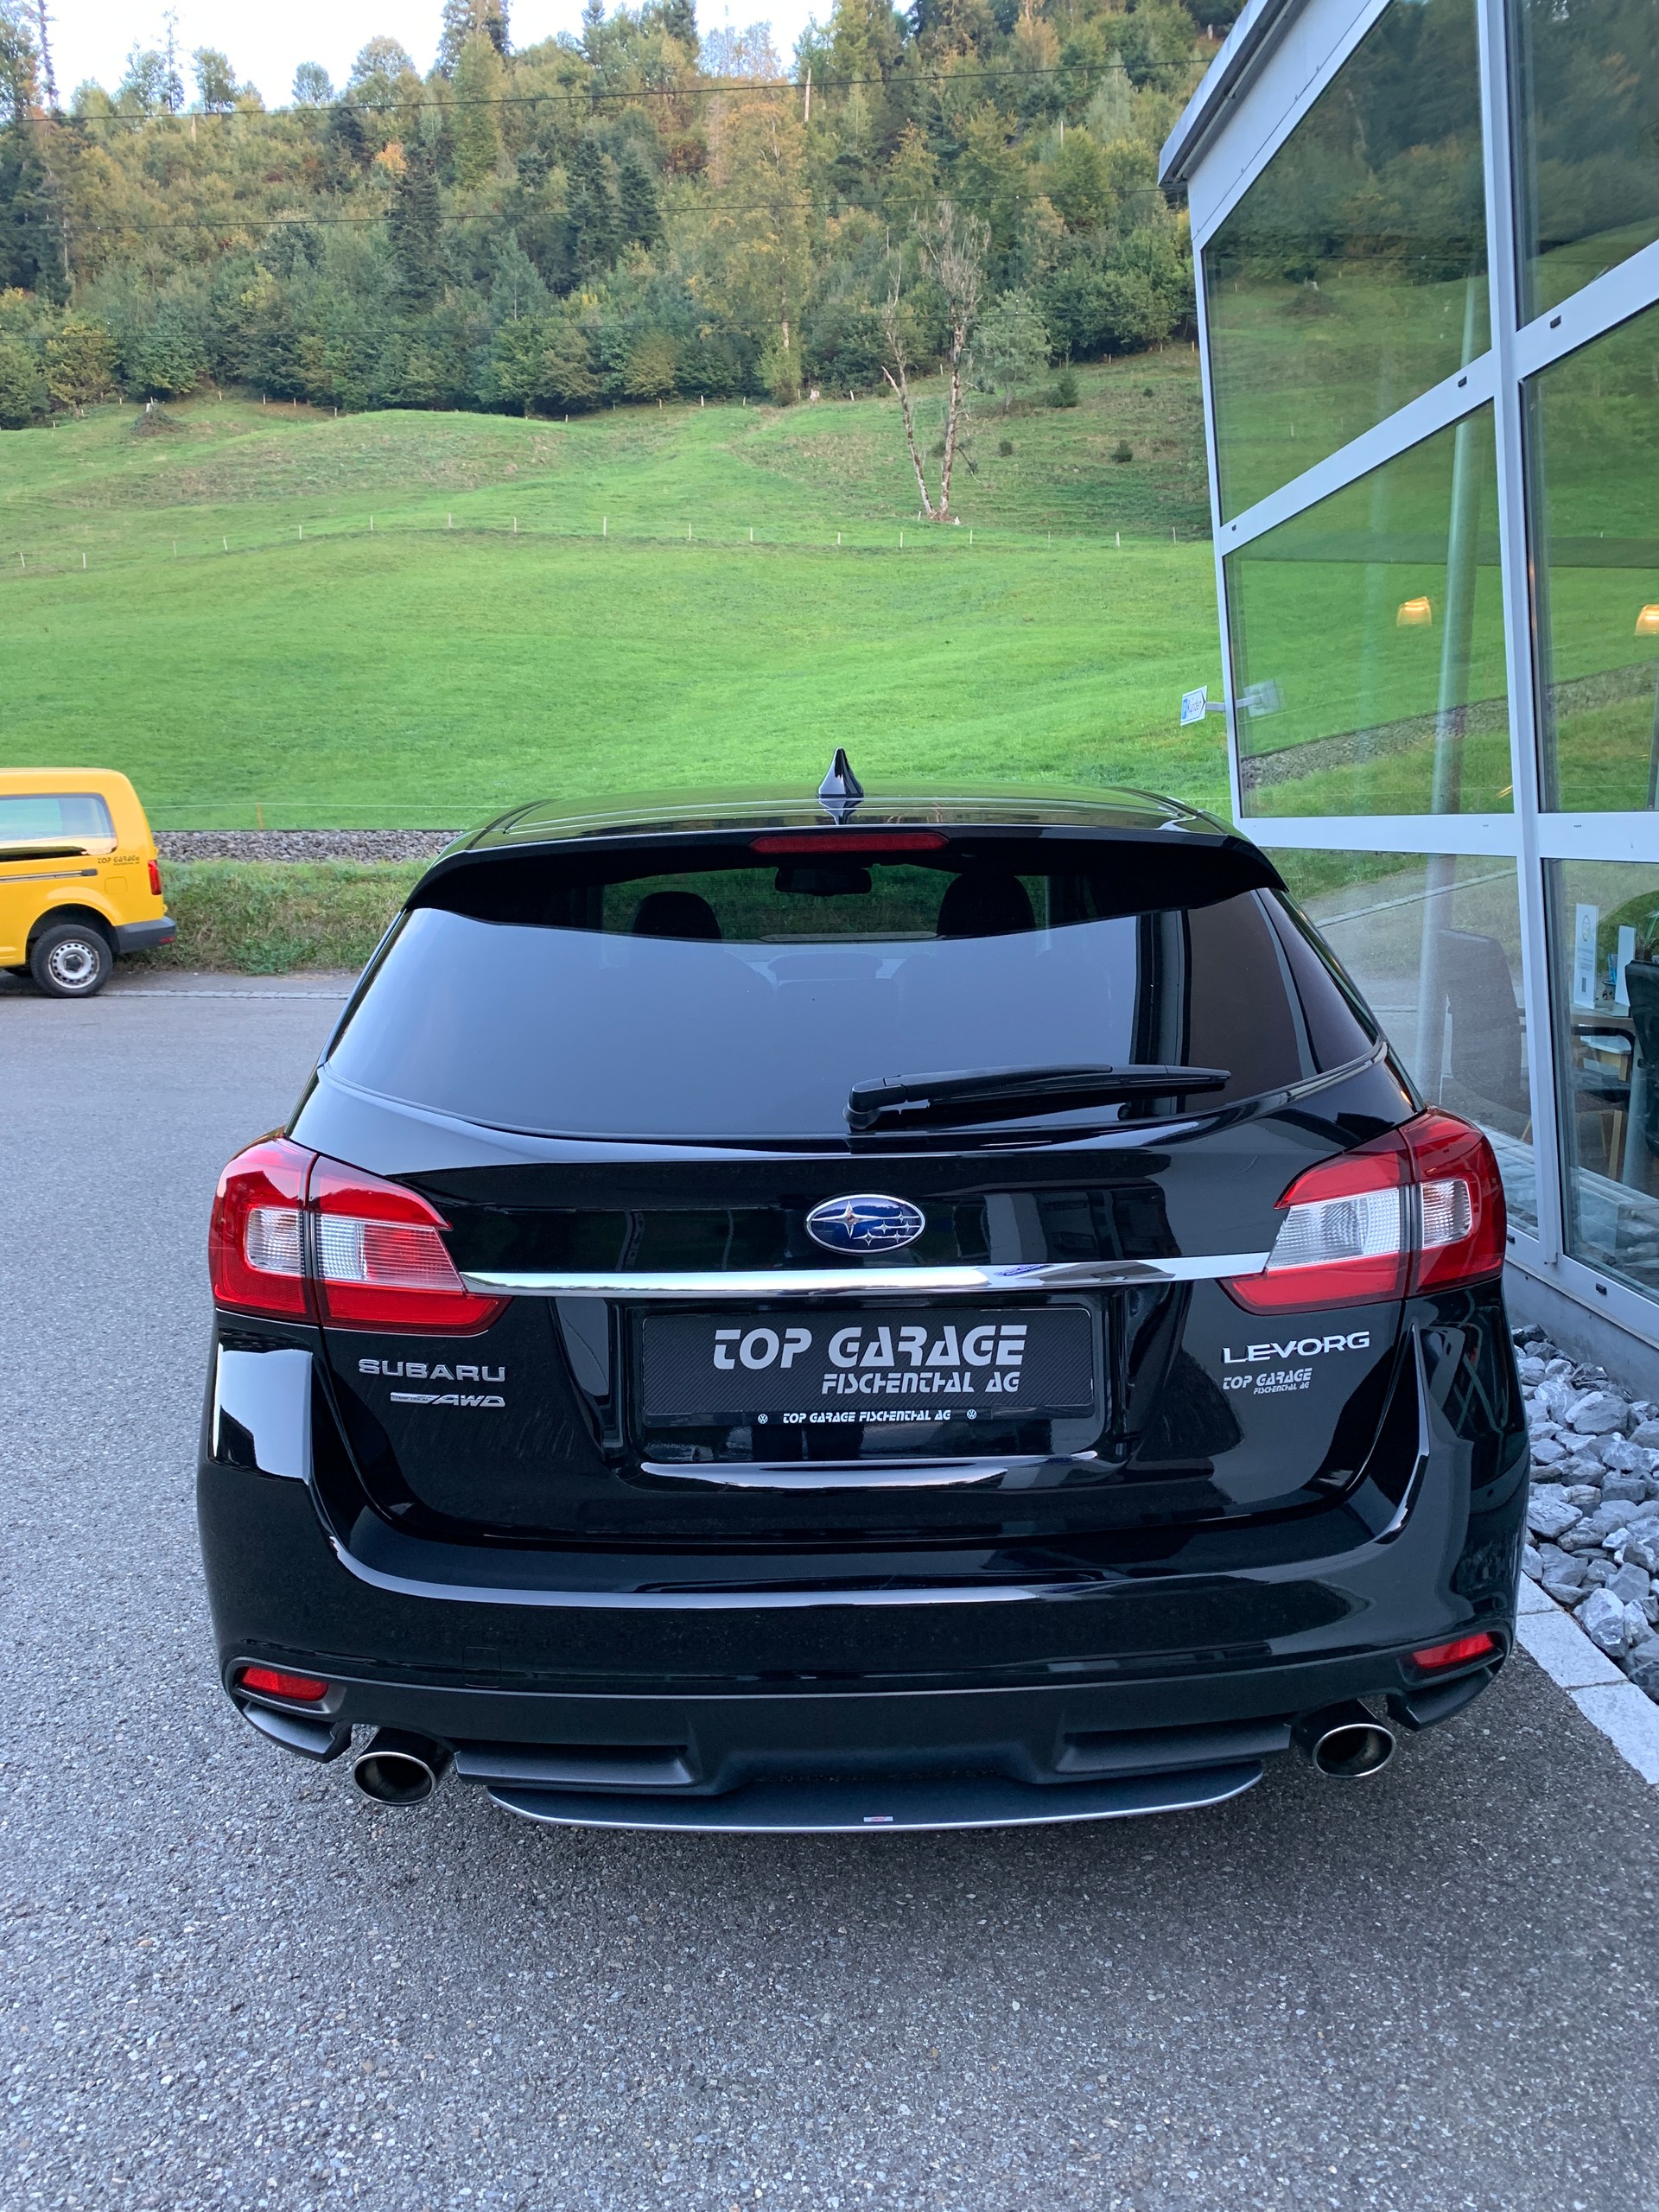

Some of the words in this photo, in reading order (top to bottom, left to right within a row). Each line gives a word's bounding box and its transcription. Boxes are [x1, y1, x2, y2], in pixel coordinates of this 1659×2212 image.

[713, 1328, 811, 1370] TOP
[828, 1325, 1028, 1368] GARAGE
[1221, 1331, 1370, 1364] LEVORG
[358, 1358, 506, 1382] SUBARU
[1223, 1375, 1252, 1390] TOP
[1255, 1367, 1313, 1387] GARAGE
[821, 1371, 975, 1395] FISCHENTHAL
[984, 1371, 1021, 1393] AG
[1253, 1382, 1298, 1395] FISCHENTHAL
[1299, 1381, 1310, 1389] AG
[432, 1394, 506, 1408] AWD
[783, 1413, 807, 1424] TOP
[809, 1412, 856, 1424] GARAGE
[858, 1410, 931, 1422] FISCHENTHAL
[934, 1409, 951, 1421] AG
